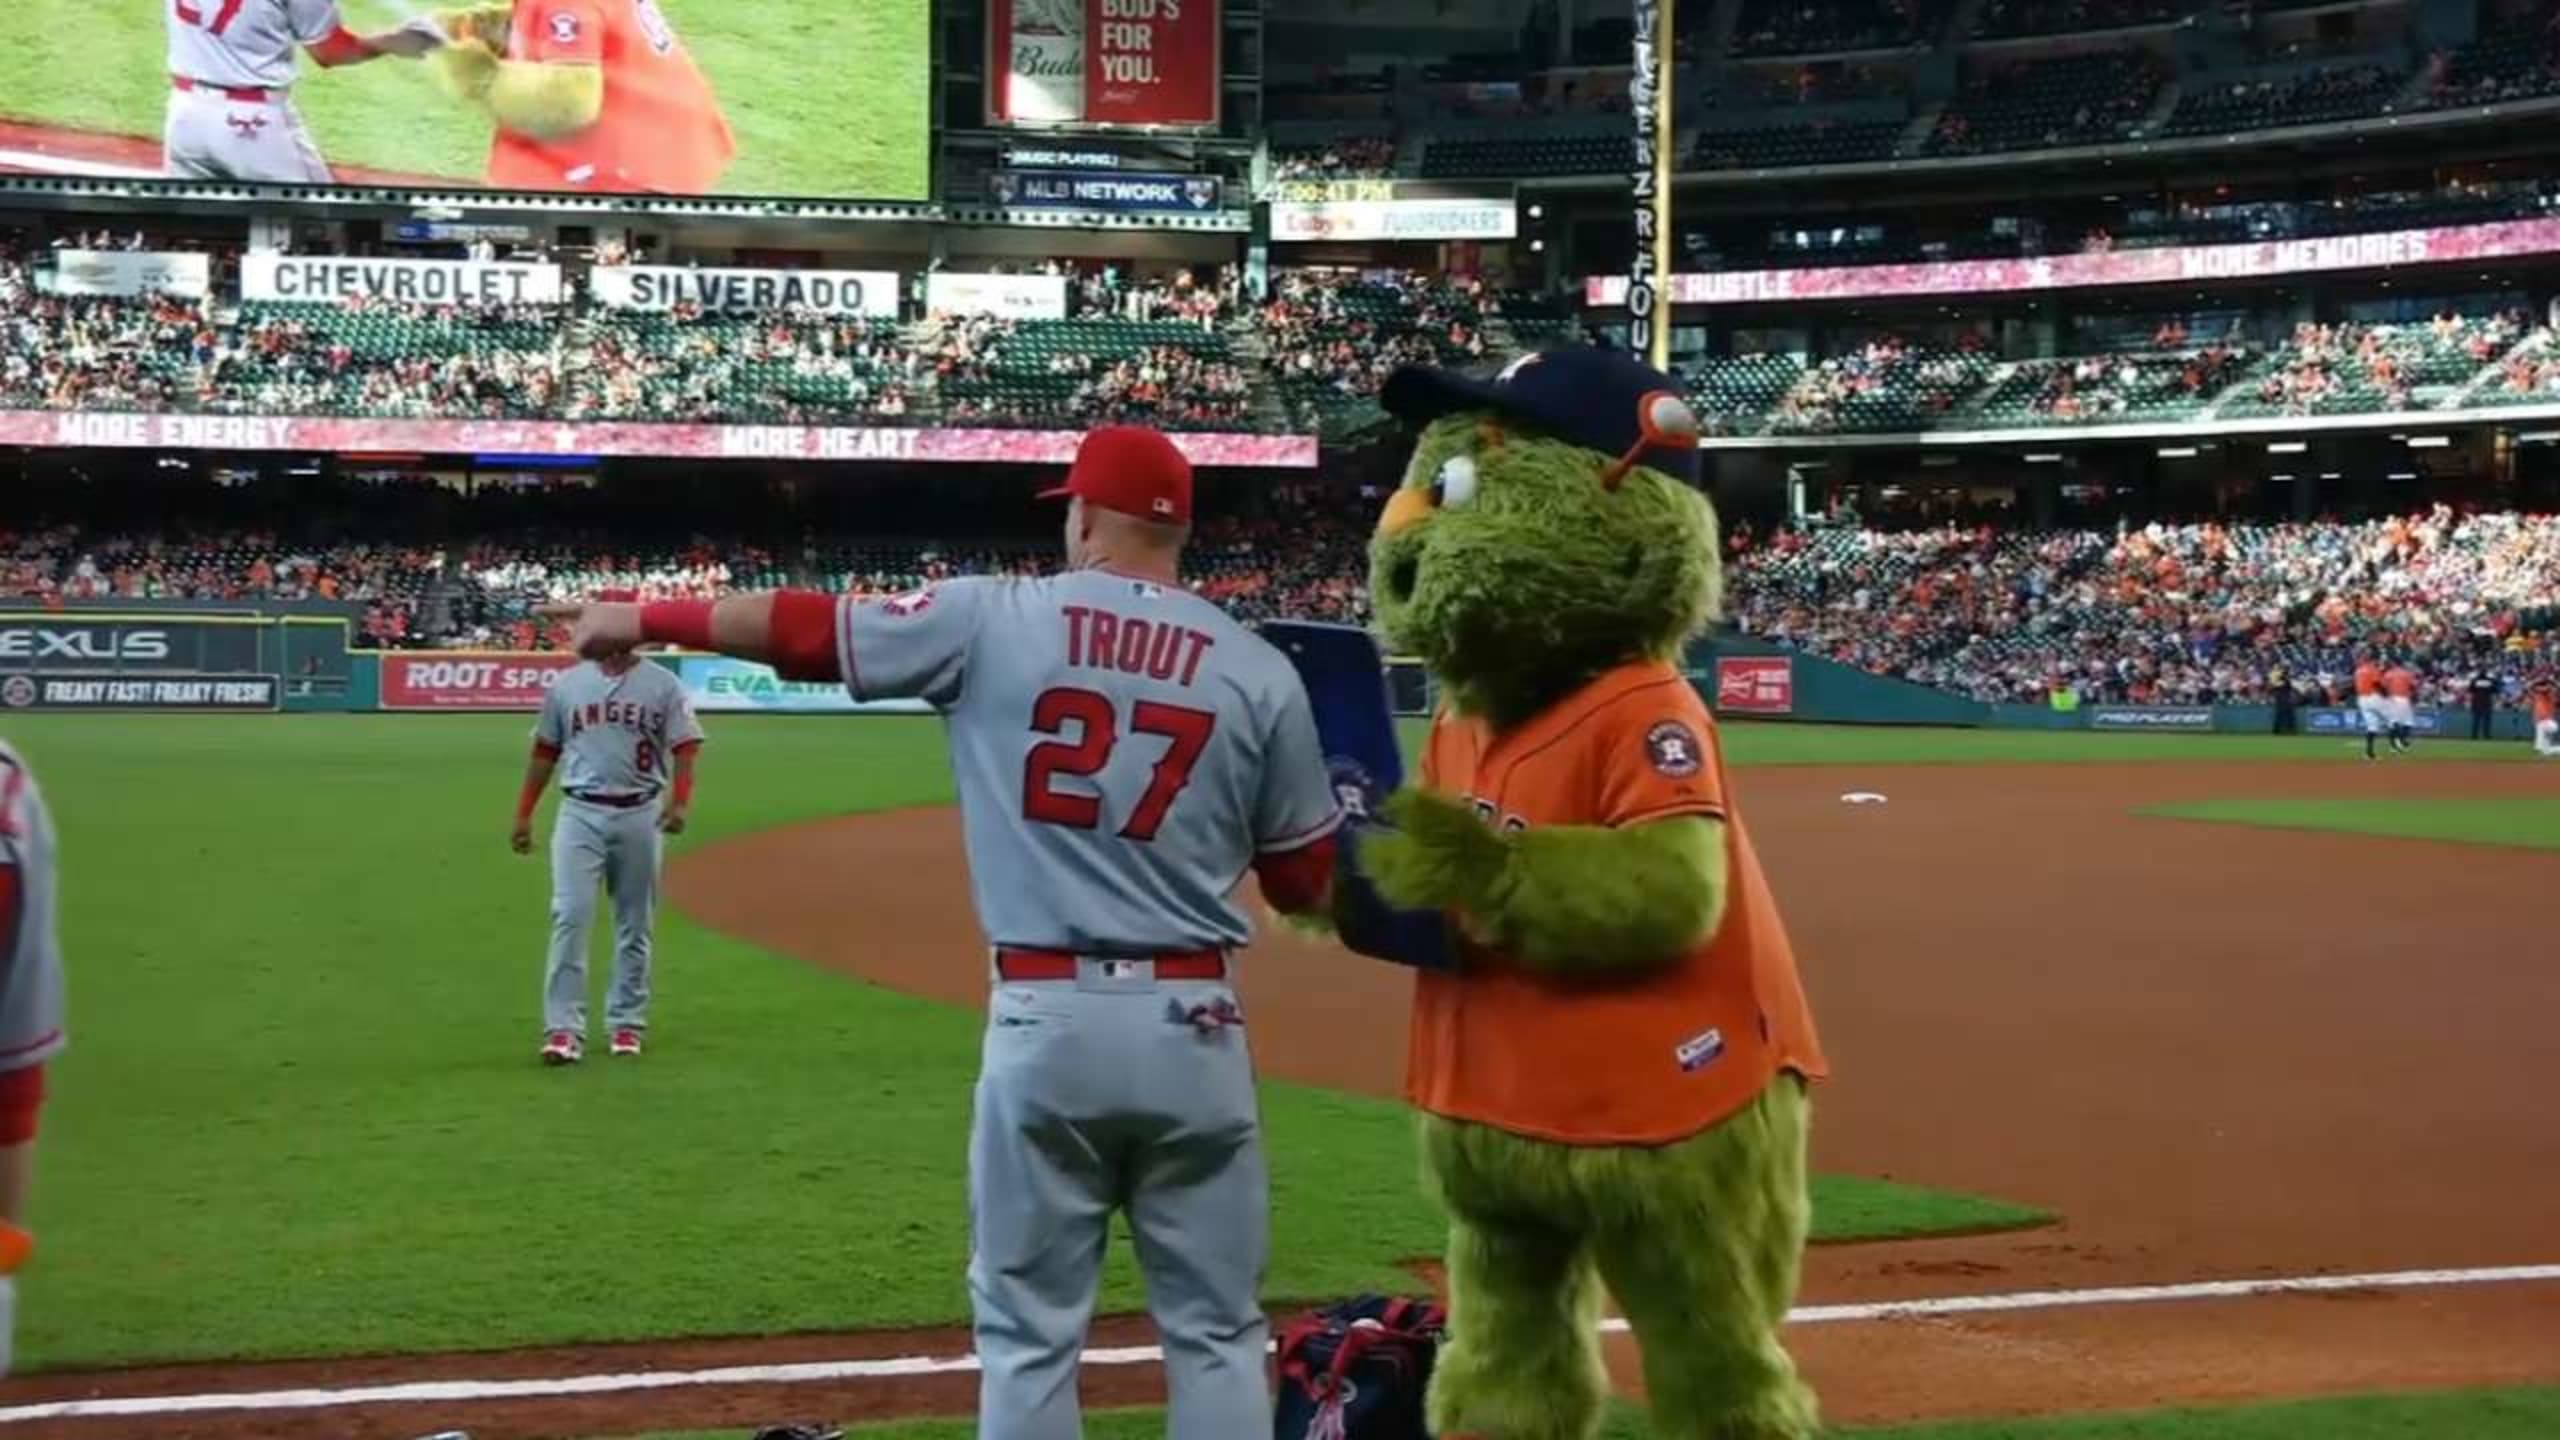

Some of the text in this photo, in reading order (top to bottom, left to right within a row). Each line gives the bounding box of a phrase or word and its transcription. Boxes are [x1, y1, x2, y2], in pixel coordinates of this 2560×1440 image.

[1101, 0, 1180, 20] BUD'S
[1101, 23, 1152, 50] FOR
[1100, 54, 1161, 84] YOU.
[1025, 181, 1179, 201] MLB NETWORK
[1357, 180, 1392, 201] PM
[2182, 231, 2427, 277] MORE MEMORIES
[274, 262, 530, 302] CHEVROLET
[630, 272, 864, 311] SILVERADO
[58, 413, 294, 447] MORE ENERGY
[722, 424, 919, 458] MORE HEART
[1062, 606, 1214, 687] TROUT
[405, 660, 562, 690] ROOT SPO
[706, 673, 775, 694] EVA
[44, 681, 105, 702] FREAKY
[153, 681, 212, 702] FREAKY
[571, 702, 667, 734] ANGELS
[635, 738, 655, 773] 8
[1022, 685, 1217, 842] 27
